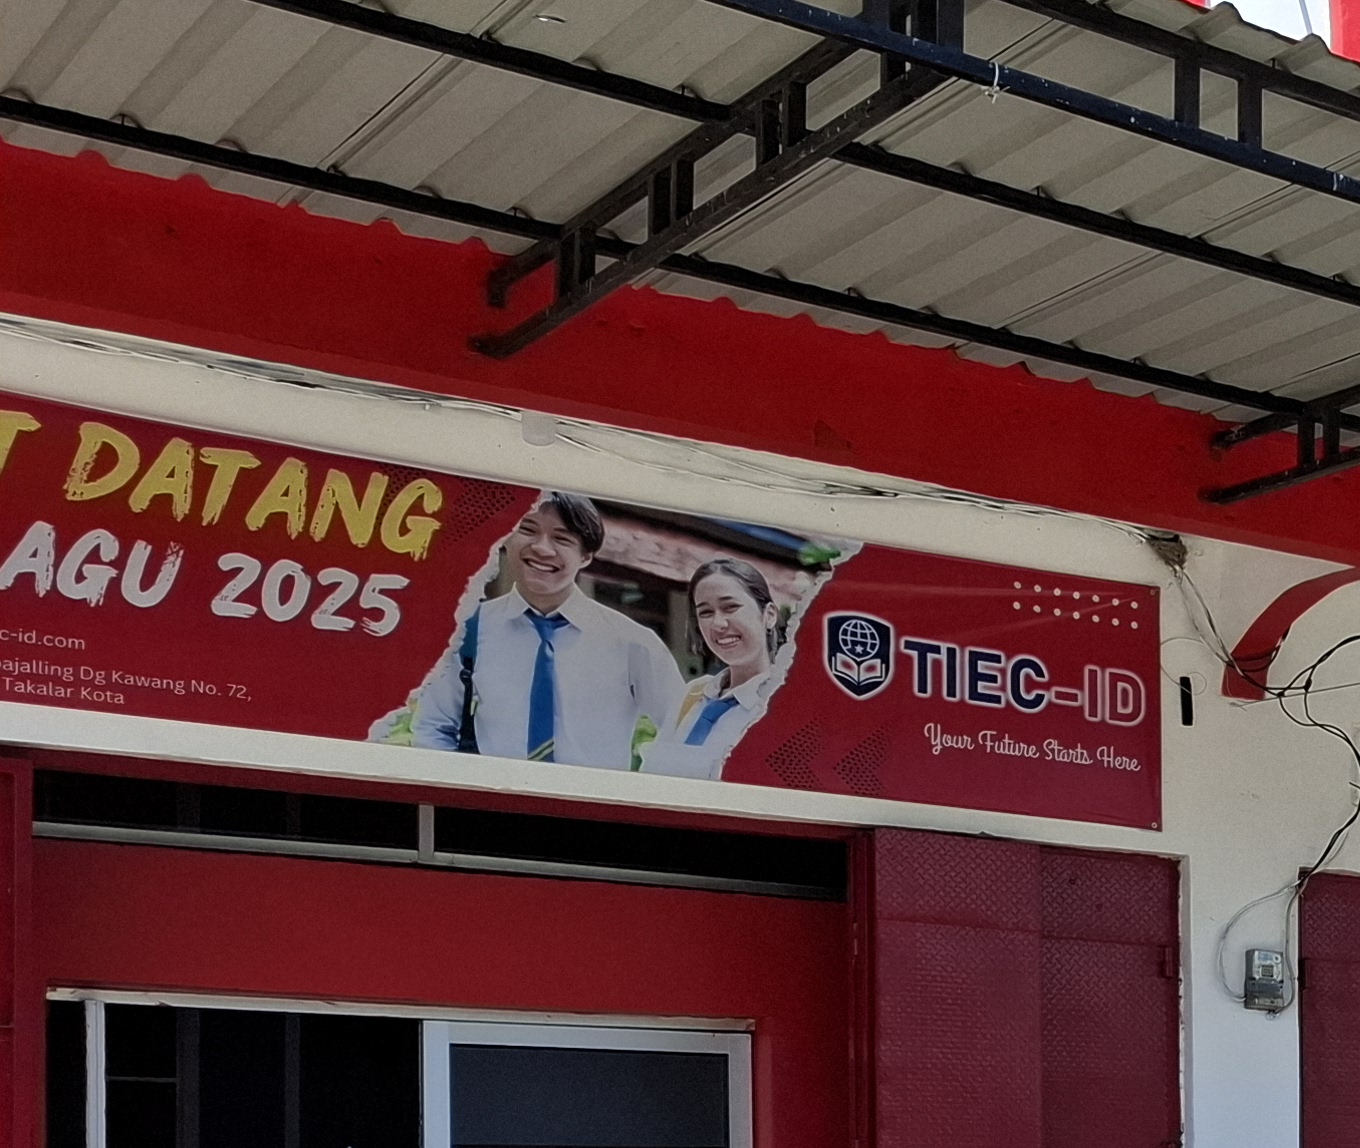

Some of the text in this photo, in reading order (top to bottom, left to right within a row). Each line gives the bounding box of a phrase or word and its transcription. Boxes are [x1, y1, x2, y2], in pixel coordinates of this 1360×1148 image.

[63, 422, 443, 562] DATANG
[0, 521, 409, 637] AGU 2025
[2, 677, 125, 704] Takalar Kota
[80, 666, 106, 685] Dg
[111, 670, 185, 695] Kawang
[190, 679, 222, 697] No.
[226, 684, 252, 702] 72,
[901, 636, 1146, 727] TIEC-ID
[924, 722, 1142, 772] Your Future Starts Here
